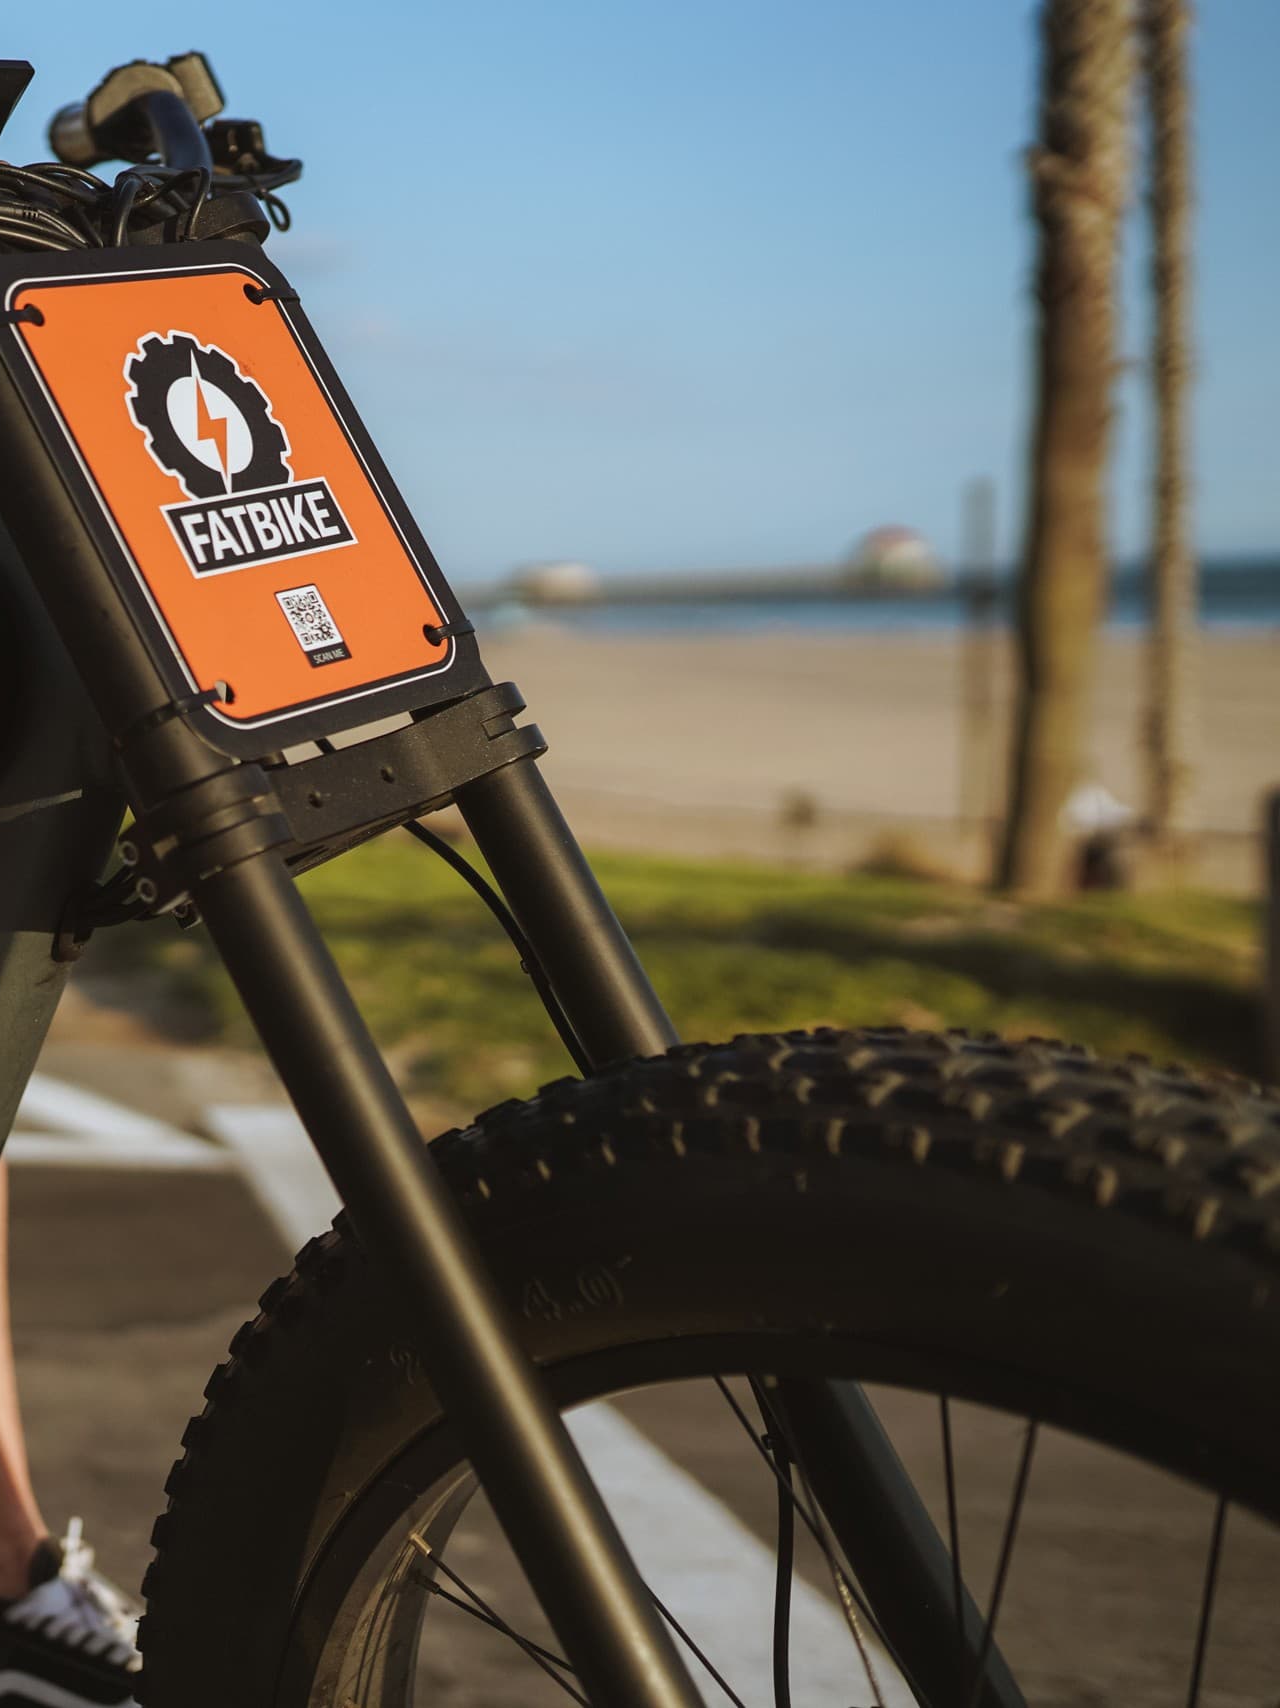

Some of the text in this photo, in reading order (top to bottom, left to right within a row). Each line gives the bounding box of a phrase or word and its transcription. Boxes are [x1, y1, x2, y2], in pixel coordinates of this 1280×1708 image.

[180, 490, 340, 564] FATBIKE
[313, 648, 346, 664] SCAN ME
